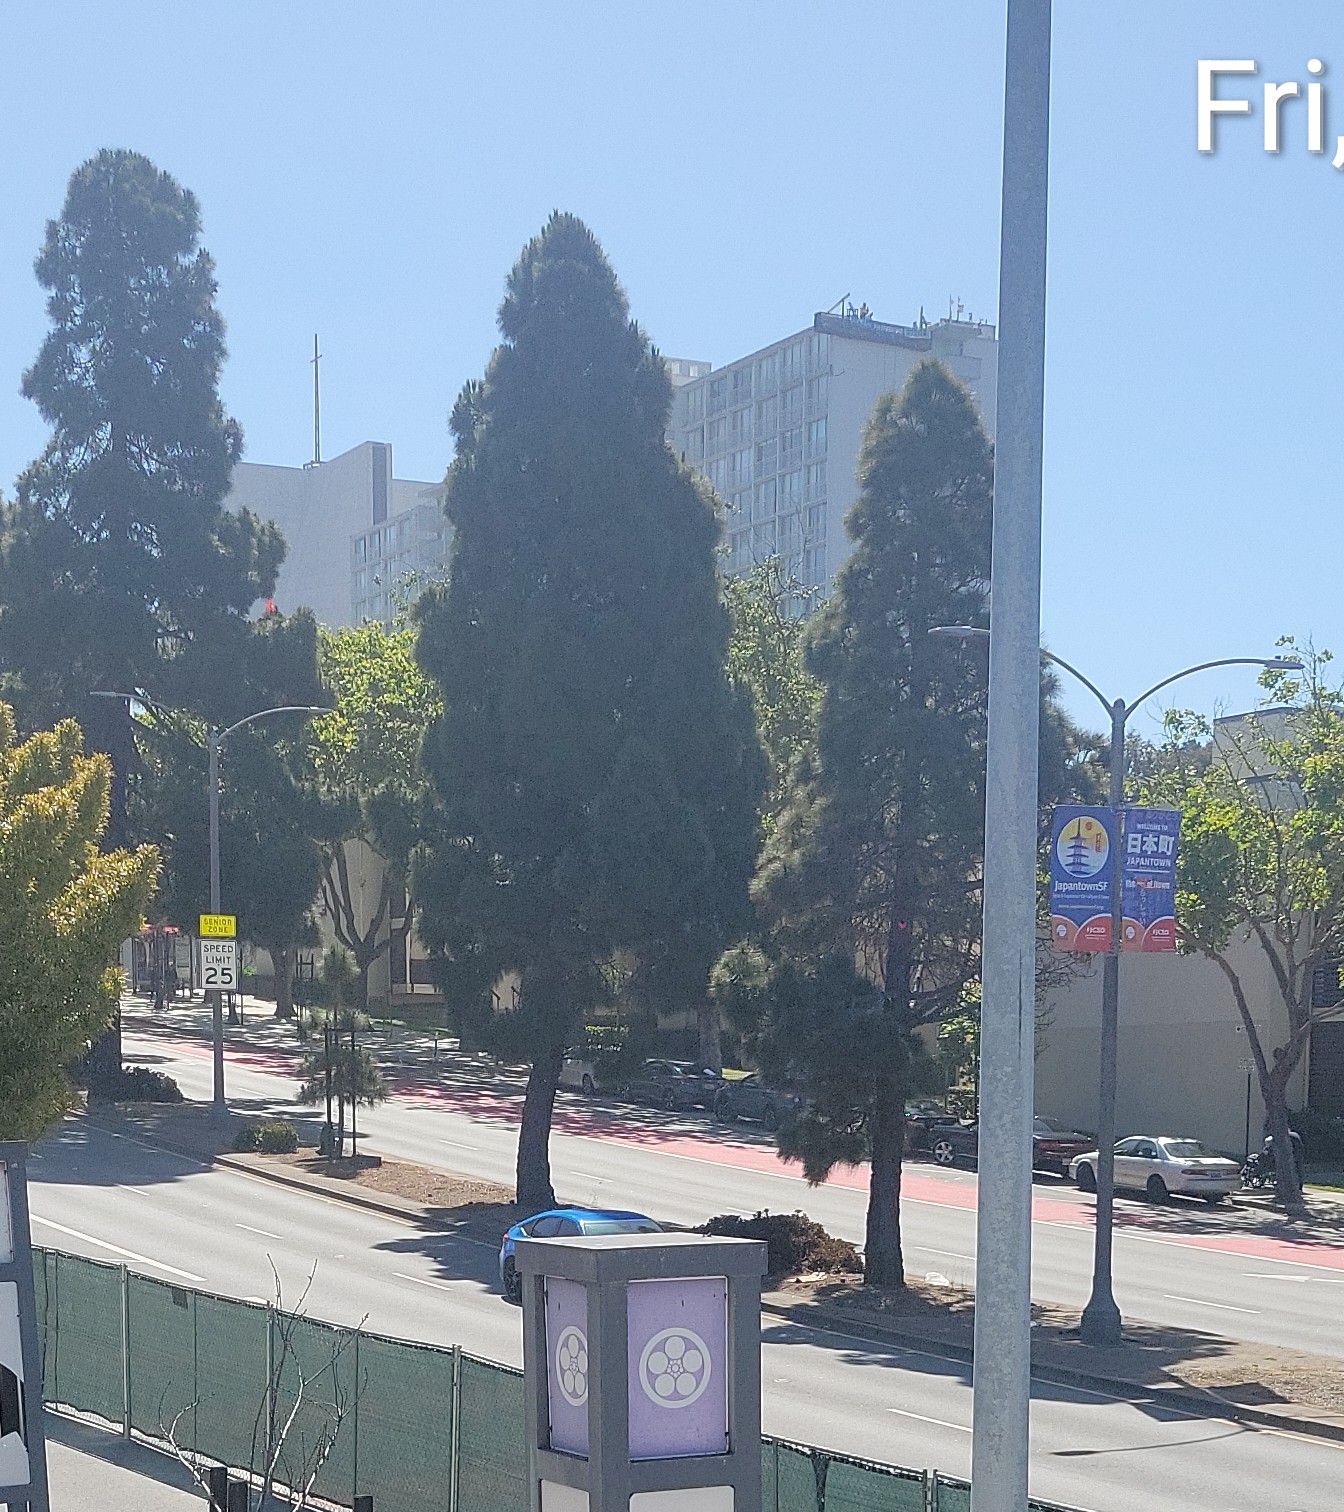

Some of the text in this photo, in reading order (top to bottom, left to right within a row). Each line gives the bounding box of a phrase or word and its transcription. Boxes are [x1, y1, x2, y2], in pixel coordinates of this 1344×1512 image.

[1127, 833, 1175, 855] 日本町
[1126, 856, 1171, 867] JAPANTOWN
[1054, 881, 1109, 892] JapantownSF
[203, 944, 233, 953] SPEED
[206, 956, 231, 964] LIMIT
[205, 967, 233, 985] 25
